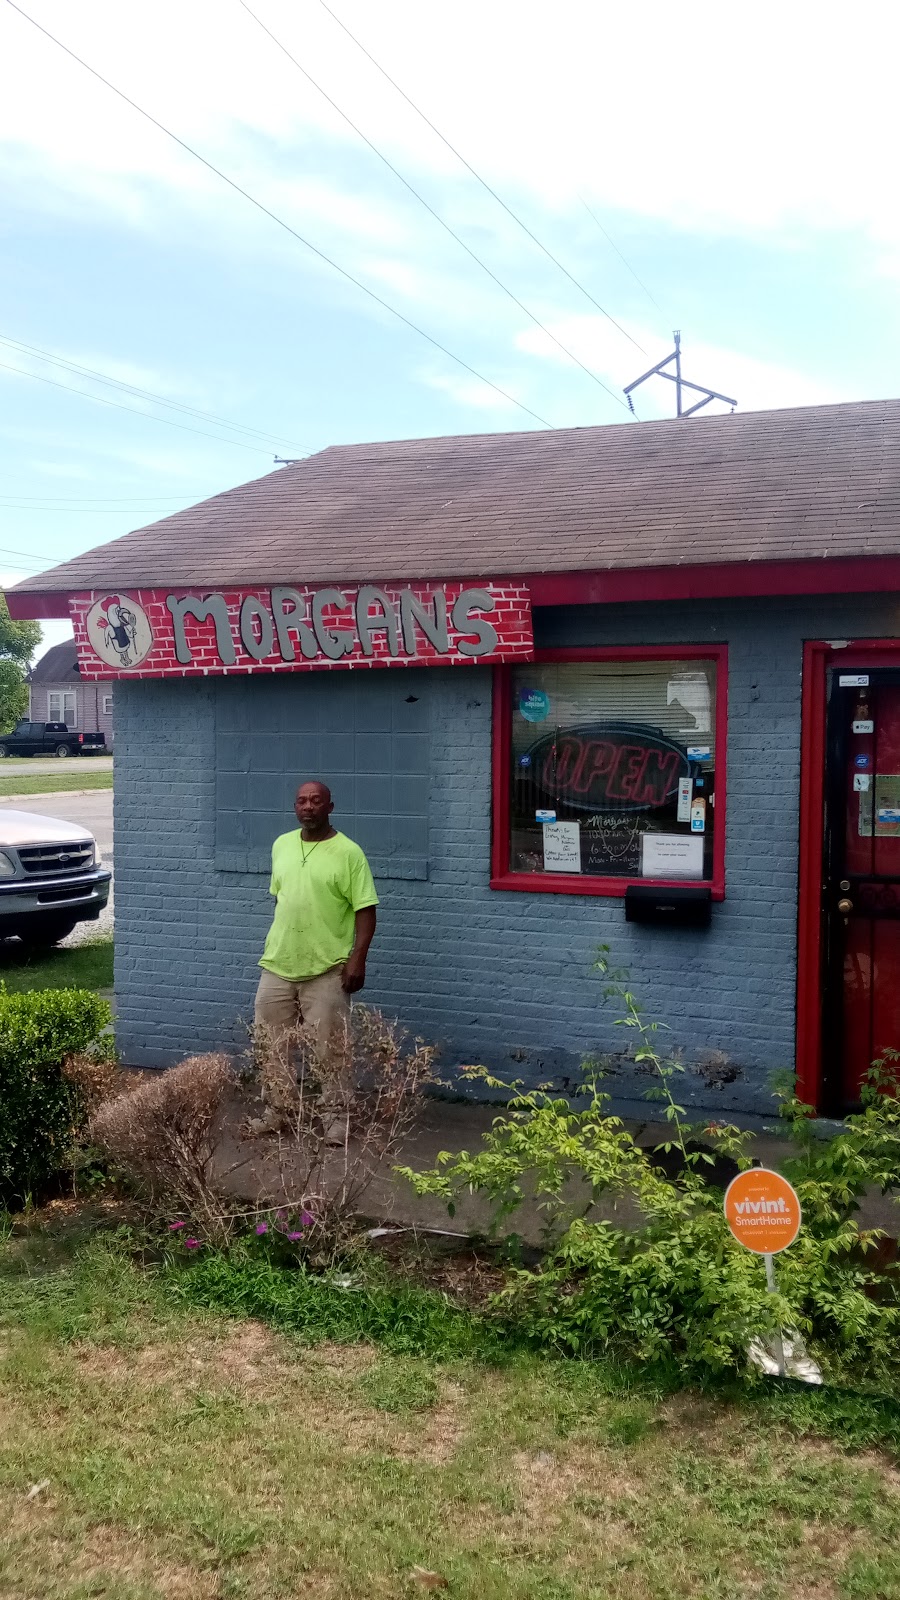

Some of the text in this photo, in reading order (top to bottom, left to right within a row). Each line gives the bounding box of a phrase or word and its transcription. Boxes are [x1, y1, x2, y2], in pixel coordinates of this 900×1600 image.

[166, 585, 499, 665] MORGANS
[543, 736, 680, 806] OPEN
[734, 1197, 790, 1214] vivint.
[735, 1216, 792, 1226] SmartHome
